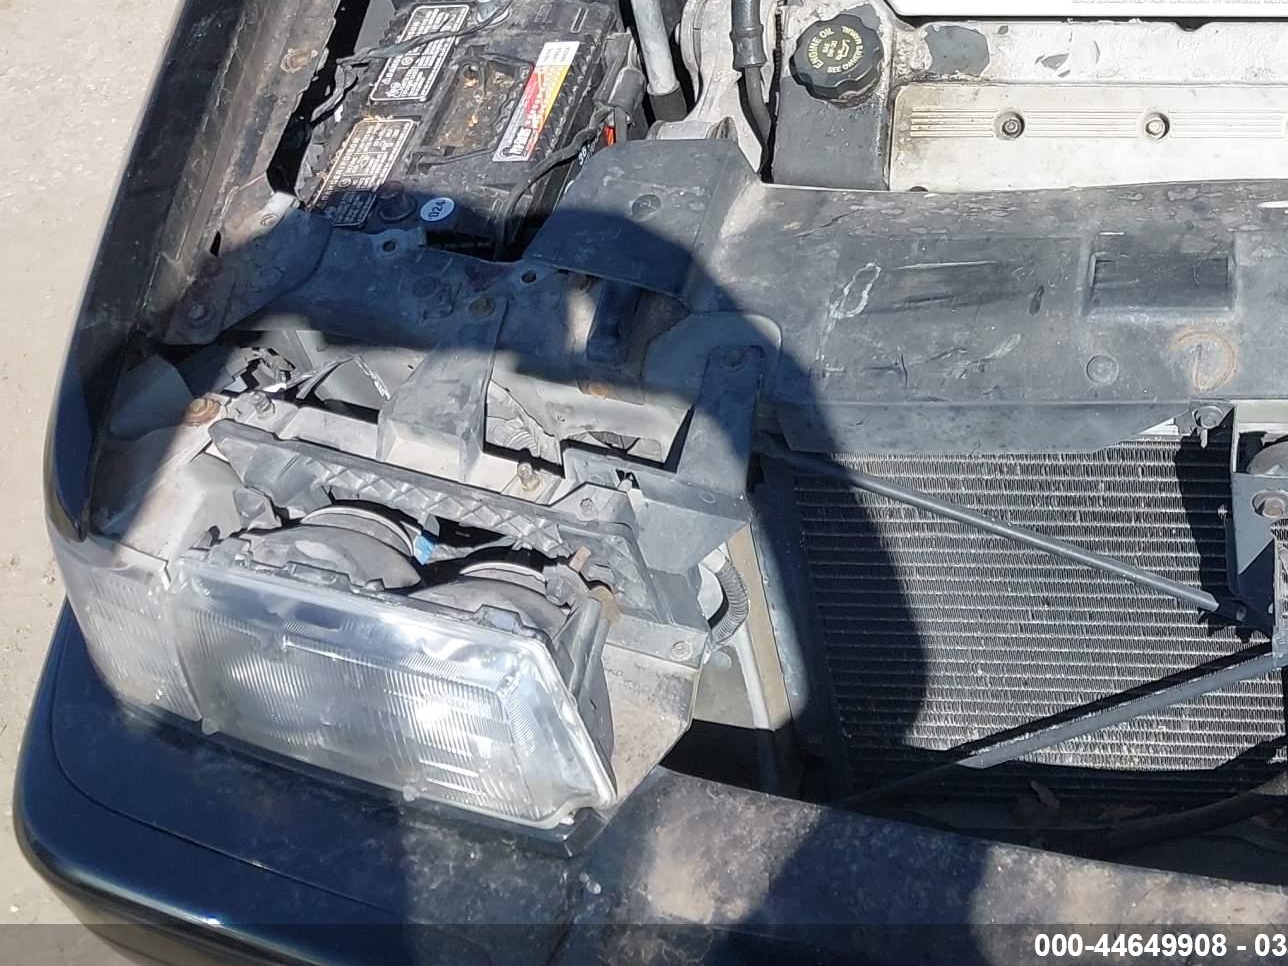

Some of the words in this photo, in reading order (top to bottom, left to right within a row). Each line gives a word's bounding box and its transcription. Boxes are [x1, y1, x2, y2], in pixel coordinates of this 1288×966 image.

[808, 37, 824, 69] ENGINE
[819, 26, 835, 39] OIL
[427, 199, 447, 219] D24
